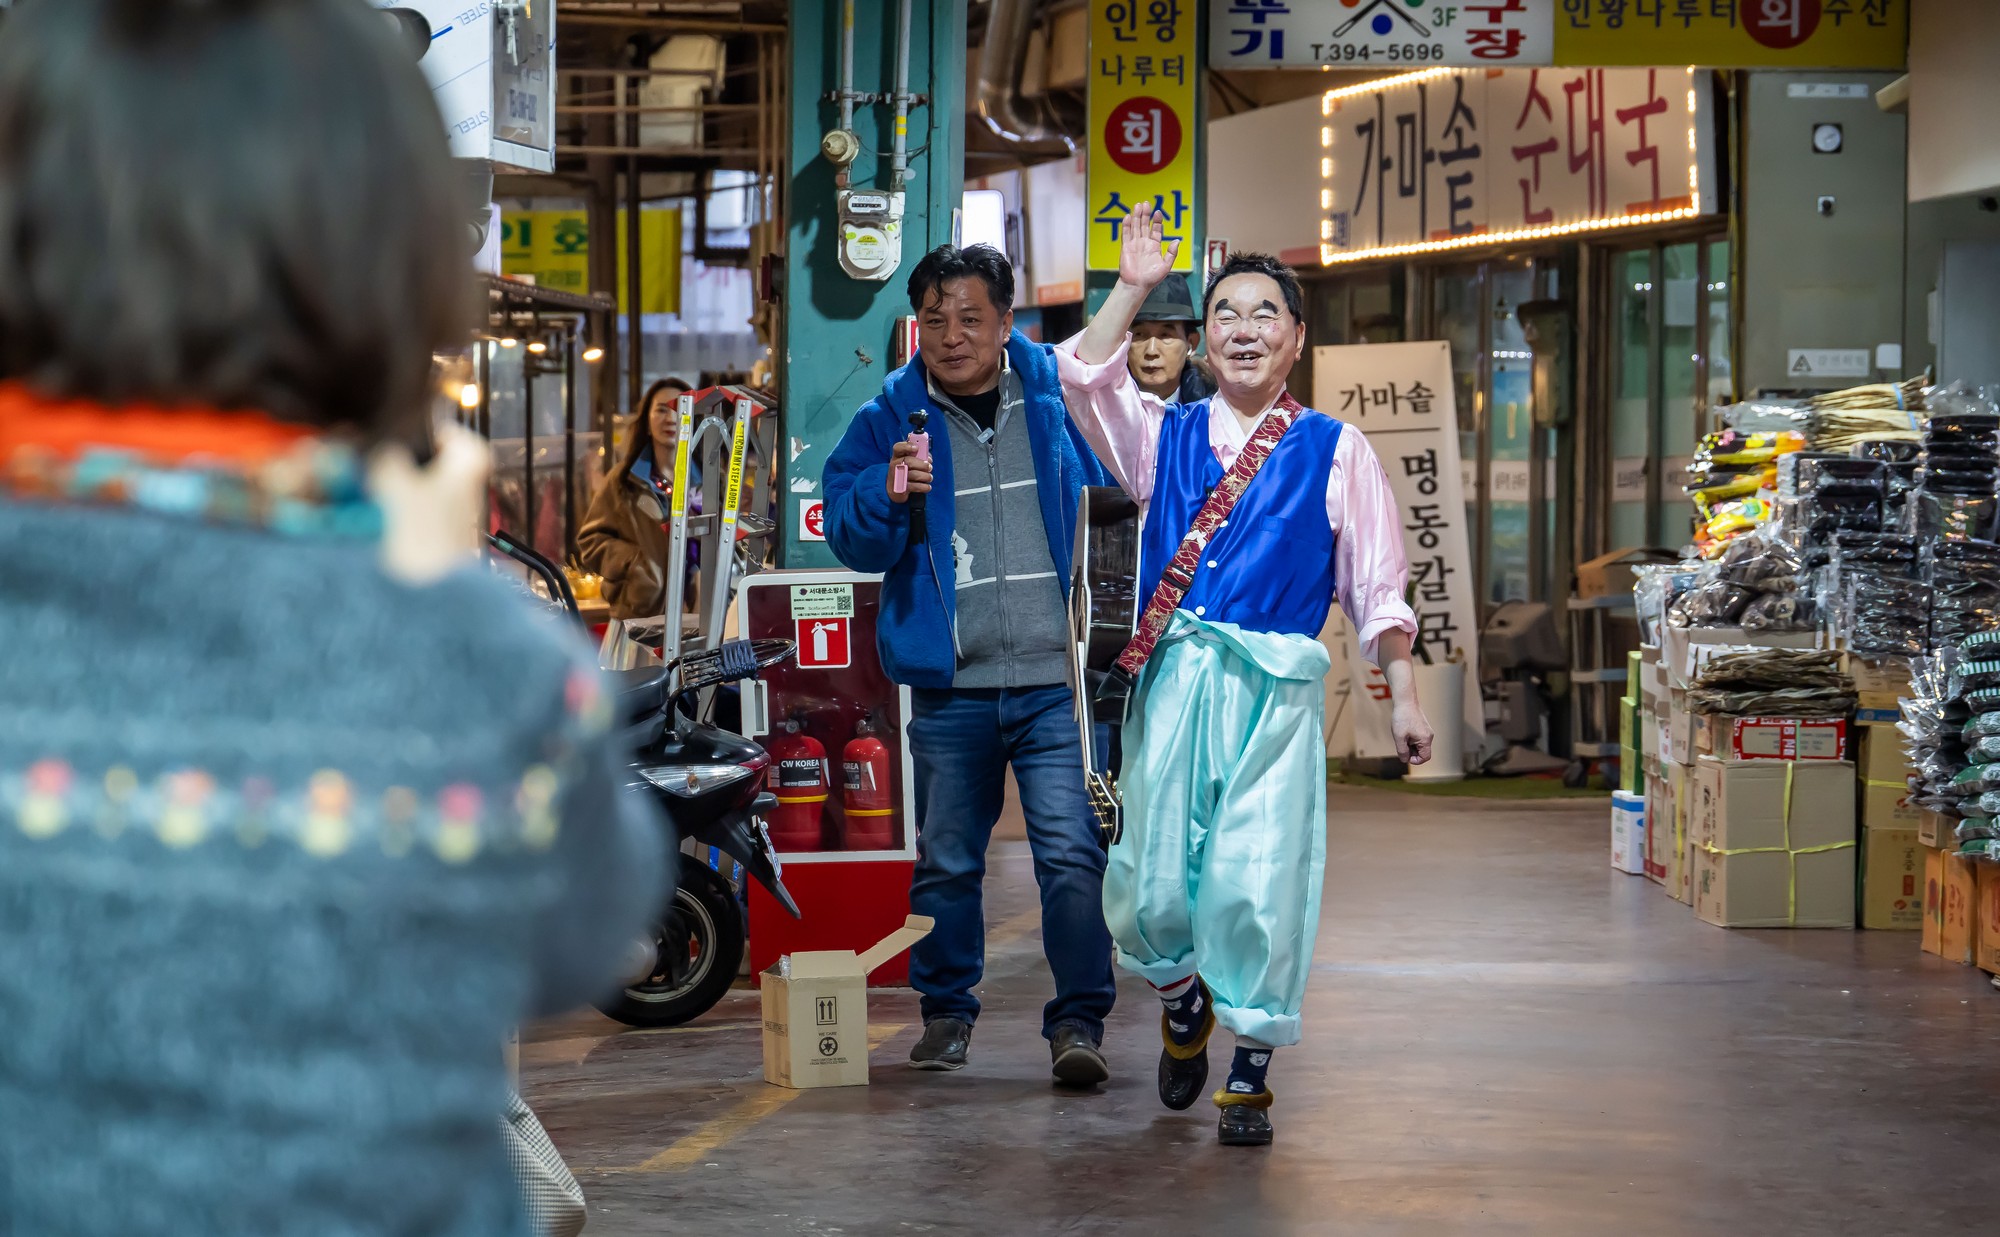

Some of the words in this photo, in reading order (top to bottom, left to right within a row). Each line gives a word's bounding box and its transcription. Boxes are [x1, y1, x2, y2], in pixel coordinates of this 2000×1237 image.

[453, 2, 489, 26] STEEL
[1105, 0, 1183, 43] 인왕
[1432, 8, 1457, 27] 3F
[1310, 43, 1444, 61] T.394-5696
[1101, 54, 1184, 86] 나루터
[451, 110, 489, 134] STEEL
[1121, 108, 1162, 165] 회
[1354, 75, 1482, 246] 가마솥
[1511, 68, 1669, 225] 순대국
[1094, 190, 1189, 242] 수산
[1340, 380, 1436, 417] 가마솥
[730, 467, 740, 484] STEP
[728, 484, 738, 509] LADDER
[781, 760, 794, 768] CW
[795, 759, 820, 768] KOREA
